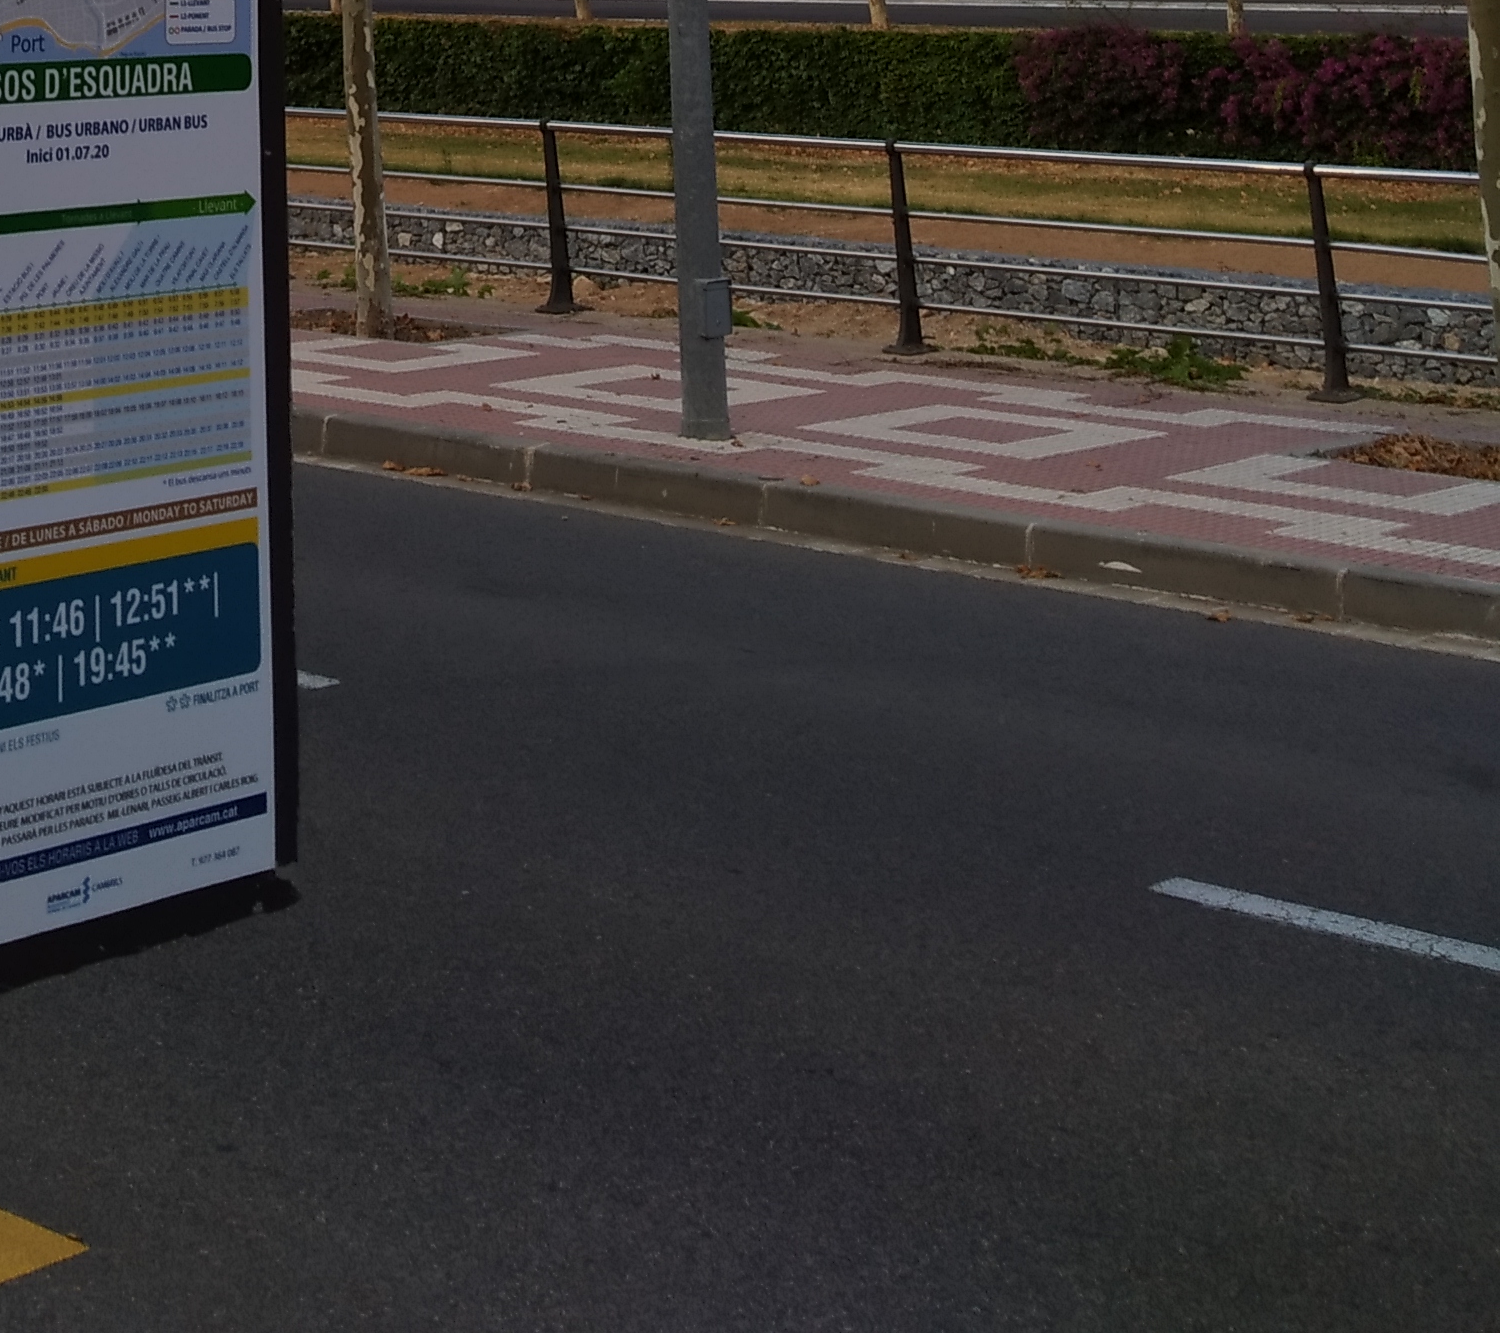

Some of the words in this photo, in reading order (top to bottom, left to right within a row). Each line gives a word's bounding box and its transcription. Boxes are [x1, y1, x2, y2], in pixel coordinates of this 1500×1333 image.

[11, 34, 44, 52] Port
[44, 61, 192, 99] D'ESQUADRA
[46, 122, 71, 139] BUS
[74, 119, 128, 137] URBANO
[139, 116, 181, 133] URBAN
[184, 114, 207, 130] BUS
[26, 147, 52, 164] Inici
[56, 144, 109, 161] 01.07.20
[198, 197, 236, 213] Llevant
[11, 531, 26, 546] DE
[30, 524, 65, 543] LUNES
[68, 522, 75, 536] A
[79, 511, 123, 534] SÁBADO
[133, 504, 180, 525] MONDAY
[183, 502, 196, 516] TO
[199, 492, 252, 513] SATURDAY
[9, 597, 84, 649] 11:46
[193, 686, 230, 706] FINALITZA
[232, 685, 238, 697] A
[240, 680, 259, 695] PORT
[8, 736, 23, 751] ELS
[26, 728, 59, 747] FESTIUS
[36, 789, 65, 806] HORARI
[87, 775, 123, 794] SUBJECTE
[124, 773, 130, 784] A
[131, 771, 141, 783] LA
[178, 758, 191, 771] DEL
[1, 828, 37, 848] PASSARÀ
[39, 824, 52, 838] PER
[54, 820, 67, 834] LES
[70, 811, 104, 830] PARADES
[151, 791, 180, 809] PASSEIG
[183, 785, 207, 801] ALBERT
[213, 776, 239, 793] CARLES
[241, 772, 257, 786] ROIG
[20, 805, 66, 827] MODIFICAT
[68, 801, 80, 815] PER
[81, 795, 106, 811] MOTIU
[108, 787, 138, 804] D'OBRES
[141, 785, 147, 796] O
[148, 779, 170, 794] TALLS
[172, 776, 181, 788] DE
[28, 852, 46, 871] ELS
[48, 841, 92, 866] HORARIS
[94, 838, 101, 853] A
[103, 834, 115, 851] LA
[117, 828, 138, 847] WEB
[149, 804, 238, 841] www.aparcam.cat
[47, 888, 80, 905] APARCAM
